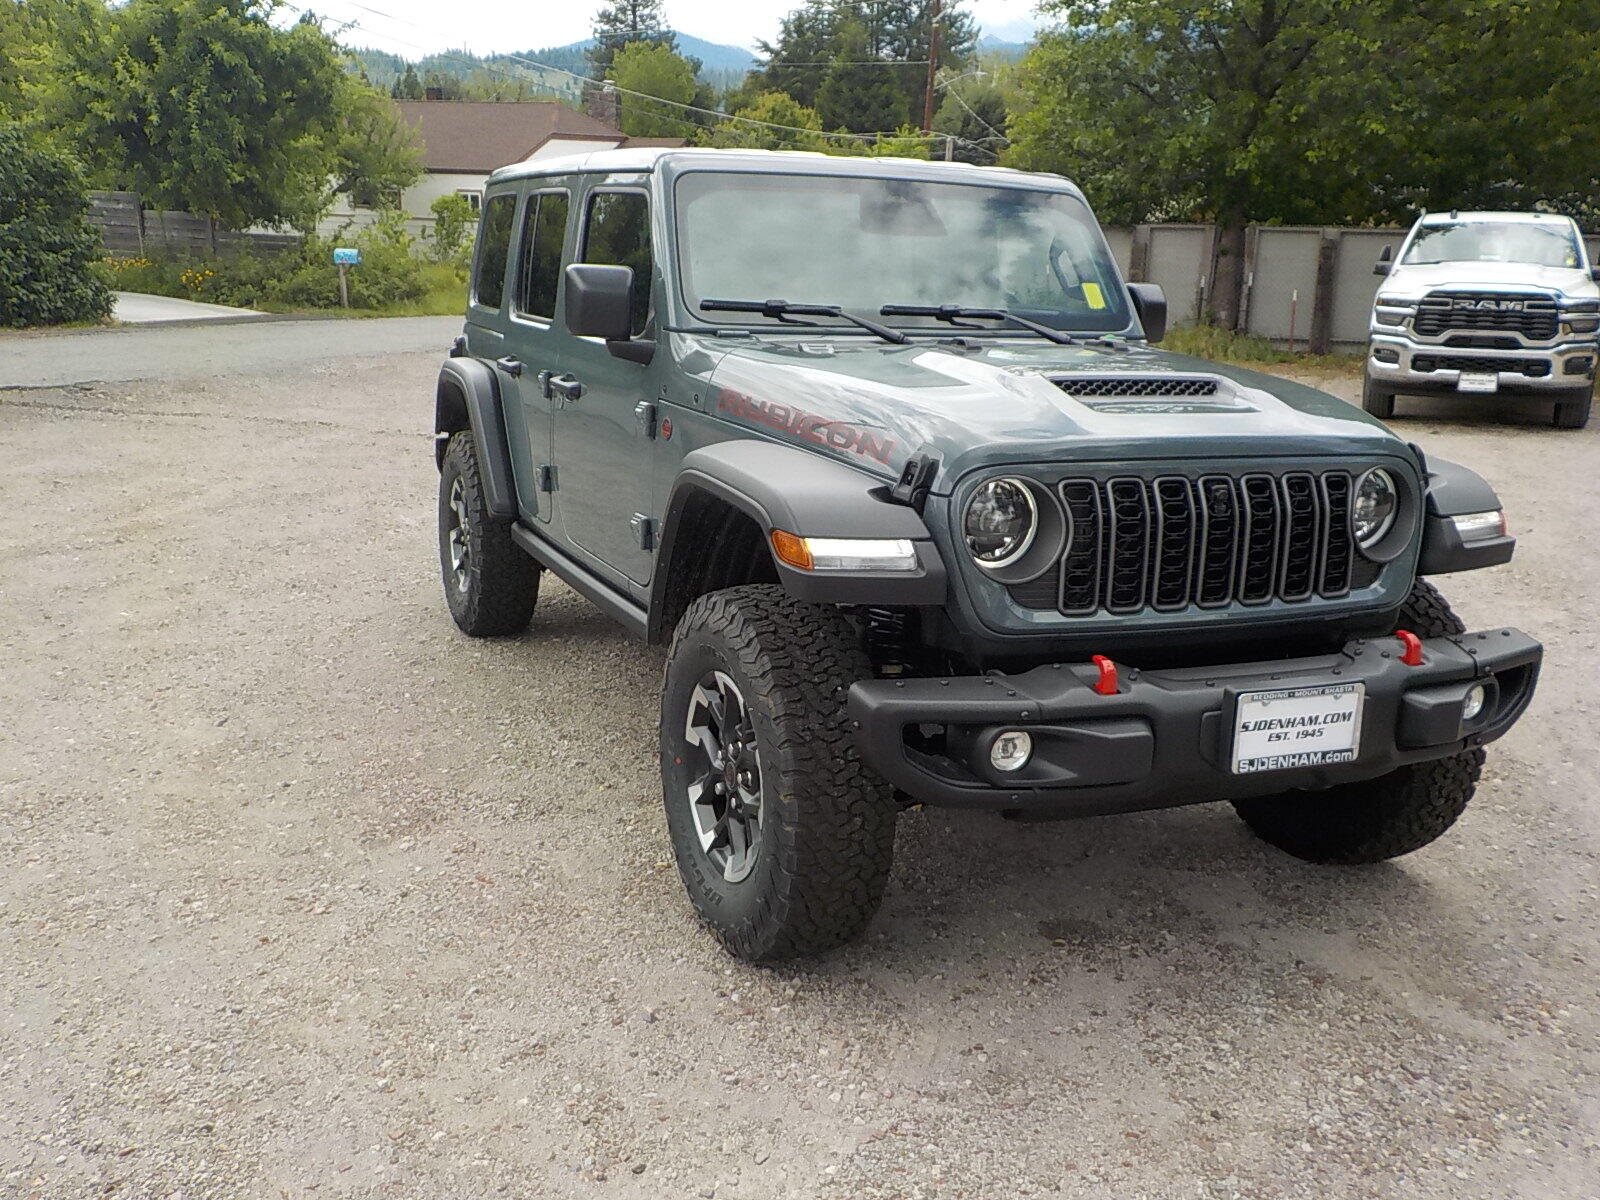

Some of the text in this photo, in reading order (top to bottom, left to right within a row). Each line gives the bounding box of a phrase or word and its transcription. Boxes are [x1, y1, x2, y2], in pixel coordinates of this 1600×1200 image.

[1452, 299, 1524, 311] RAM
[718, 385, 896, 465] RUBICON
[1253, 685, 1354, 701] REDDING MOUNT SHASTA
[1241, 711, 1353, 733] SJDENHAM.COM
[1267, 727, 1325, 742] EST. 1945
[1239, 751, 1353, 773] SJDENHAM.com
